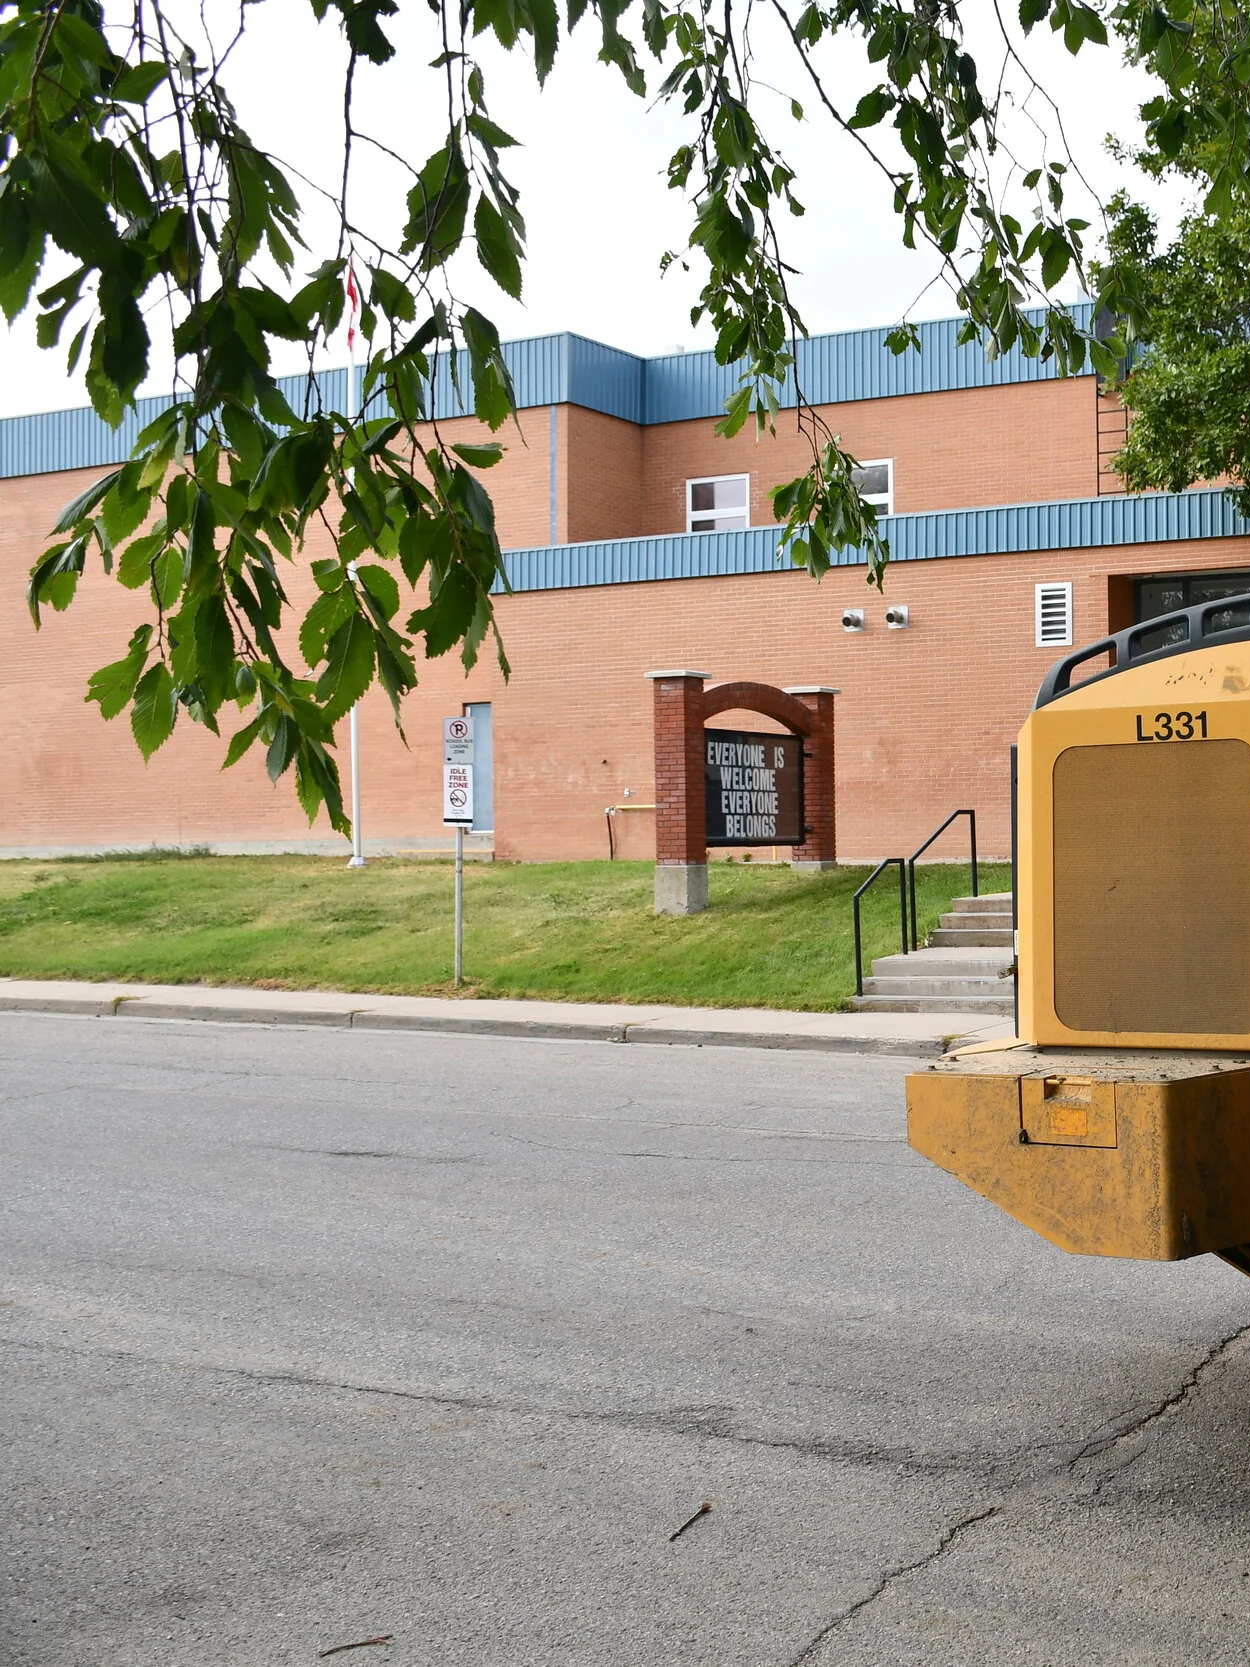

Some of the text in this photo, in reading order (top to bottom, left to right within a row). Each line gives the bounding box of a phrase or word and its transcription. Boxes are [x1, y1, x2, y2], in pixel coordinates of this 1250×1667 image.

[1136, 711, 1209, 742] L331
[707, 741, 785, 769] EVERYONE IS
[720, 766, 777, 791] WELCOME
[721, 791, 779, 814] EVERYONE
[726, 814, 777, 838] BELONGS
